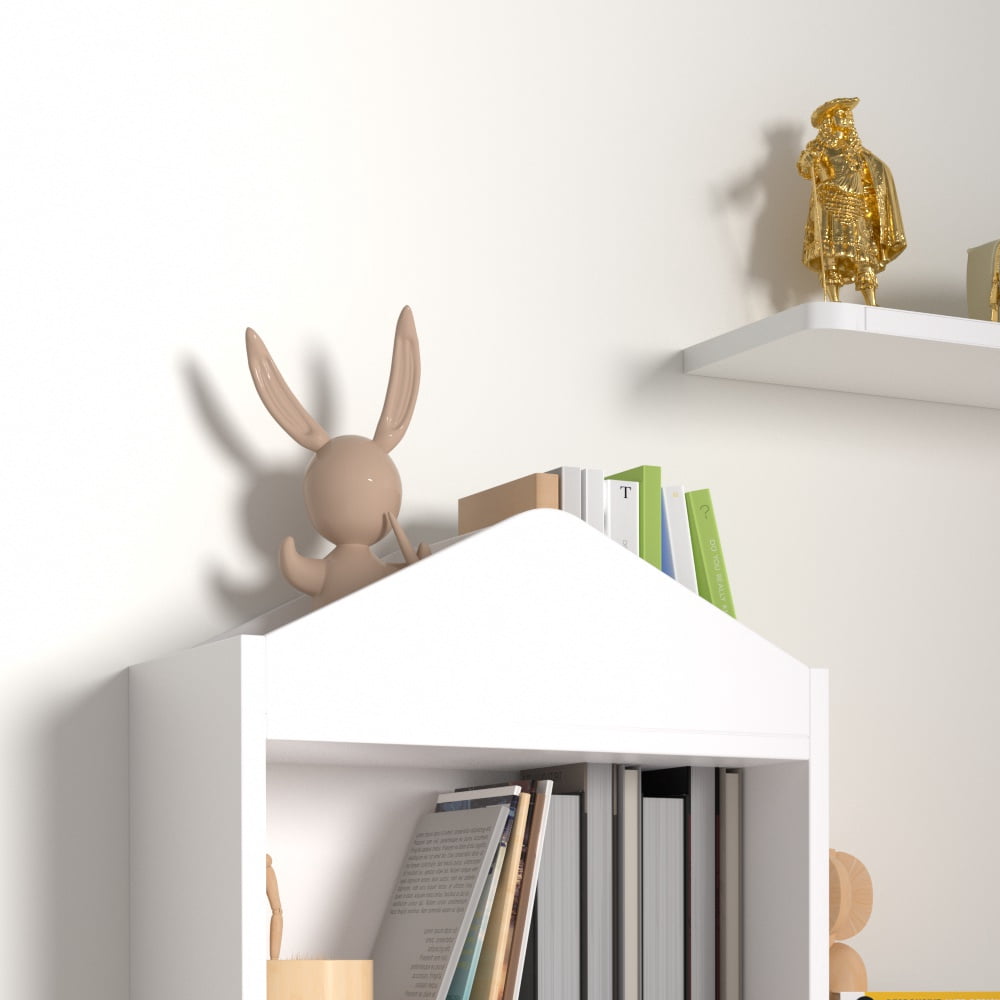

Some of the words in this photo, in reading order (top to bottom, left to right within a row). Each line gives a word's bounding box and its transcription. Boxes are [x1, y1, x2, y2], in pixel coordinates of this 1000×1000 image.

[620, 485, 631, 499] T
[709, 539, 716, 552] DO
[712, 554, 720, 571] YOU
[715, 574, 725, 602] REALLY
